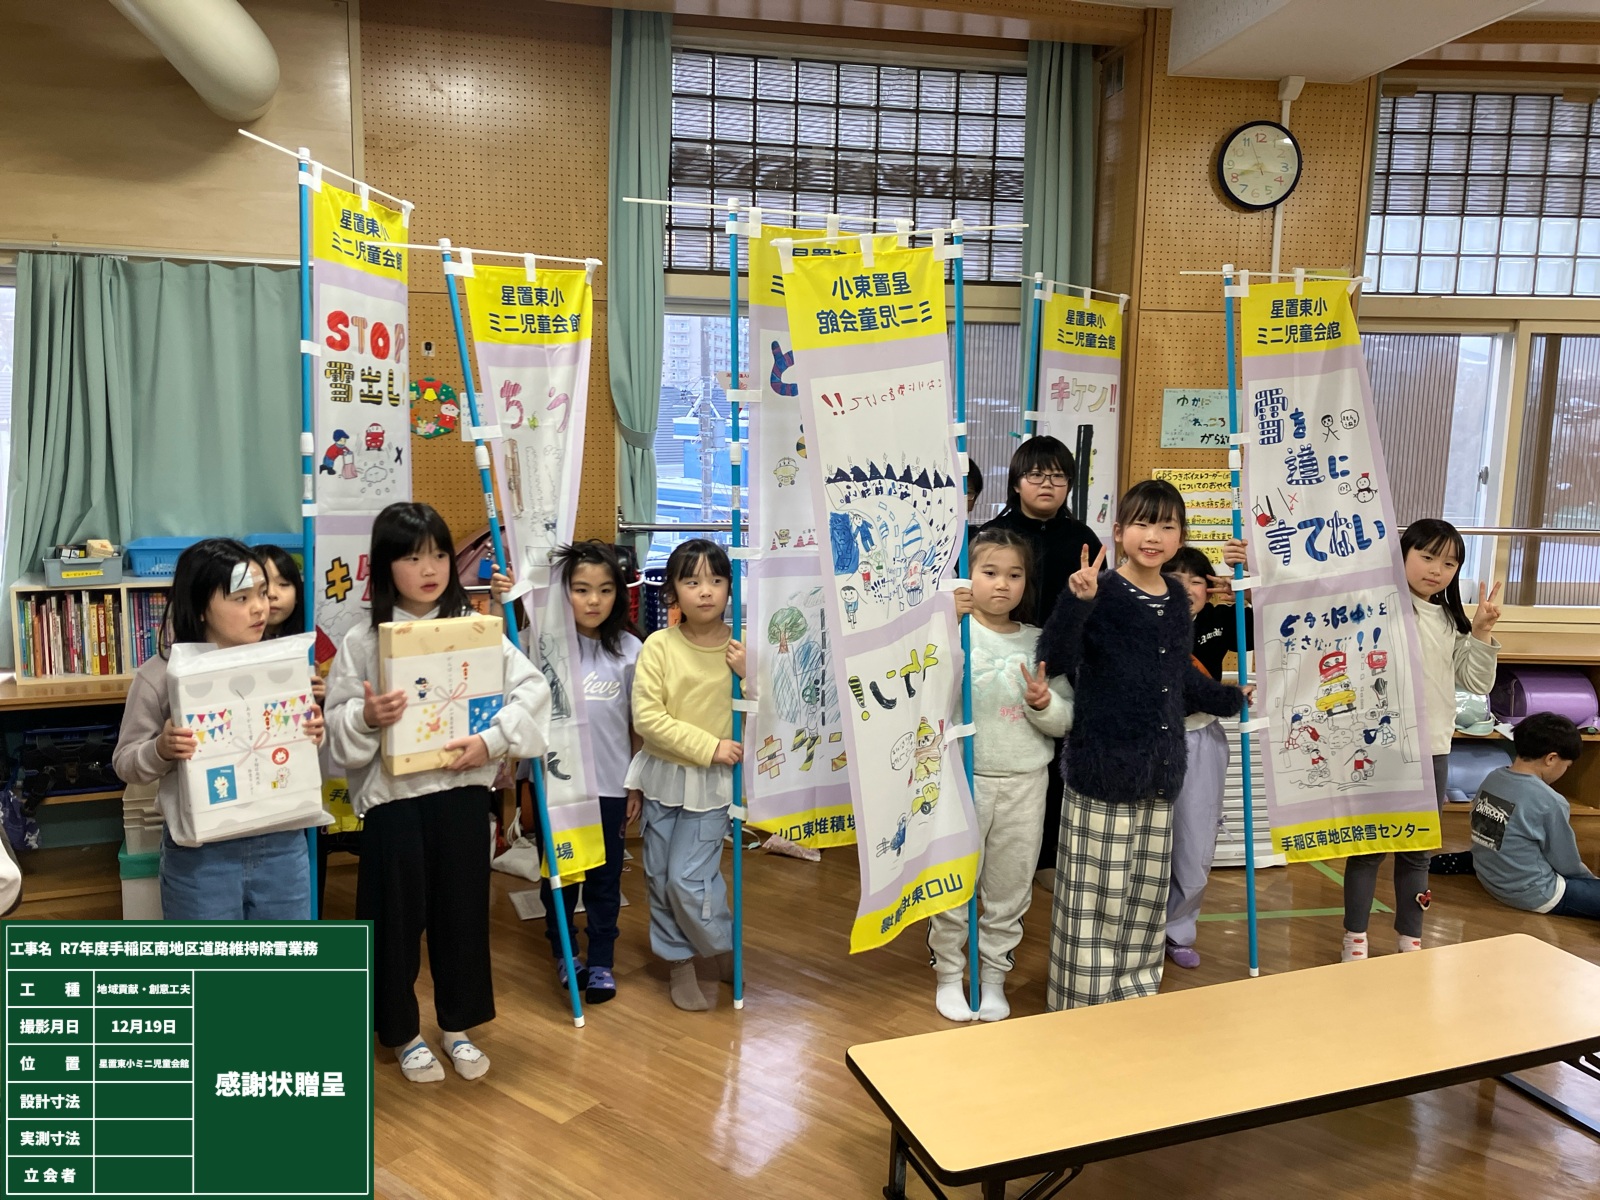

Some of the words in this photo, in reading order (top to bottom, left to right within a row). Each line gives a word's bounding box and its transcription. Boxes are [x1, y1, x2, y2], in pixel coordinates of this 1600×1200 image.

[1243, 138, 1250, 147] 11
[1255, 132, 1267, 143] 12
[1232, 148, 1244, 158] 10
[1277, 149, 1286, 158] 2
[1227, 160, 1235, 169] 9
[1281, 162, 1289, 172] 3
[1231, 173, 1239, 183] 8
[1274, 176, 1284, 185] 4
[1239, 184, 1248, 193] 7
[1251, 188, 1260, 198] 6
[1264, 185, 1273, 195] 5
[501, 285, 565, 307] 星置東小
[1270, 297, 1328, 318] 星置東小
[1065, 309, 1107, 329] 星置東小
[326, 310, 405, 363] STOP
[1257, 321, 1342, 345] ミニ児童会館
[1057, 328, 1116, 350] ミニ児童会館
[325, 361, 406, 407] 雪出し
[1285, 443, 1350, 485] 道に
[1281, 822, 1430, 852] 手稲区南地区除雪センター
